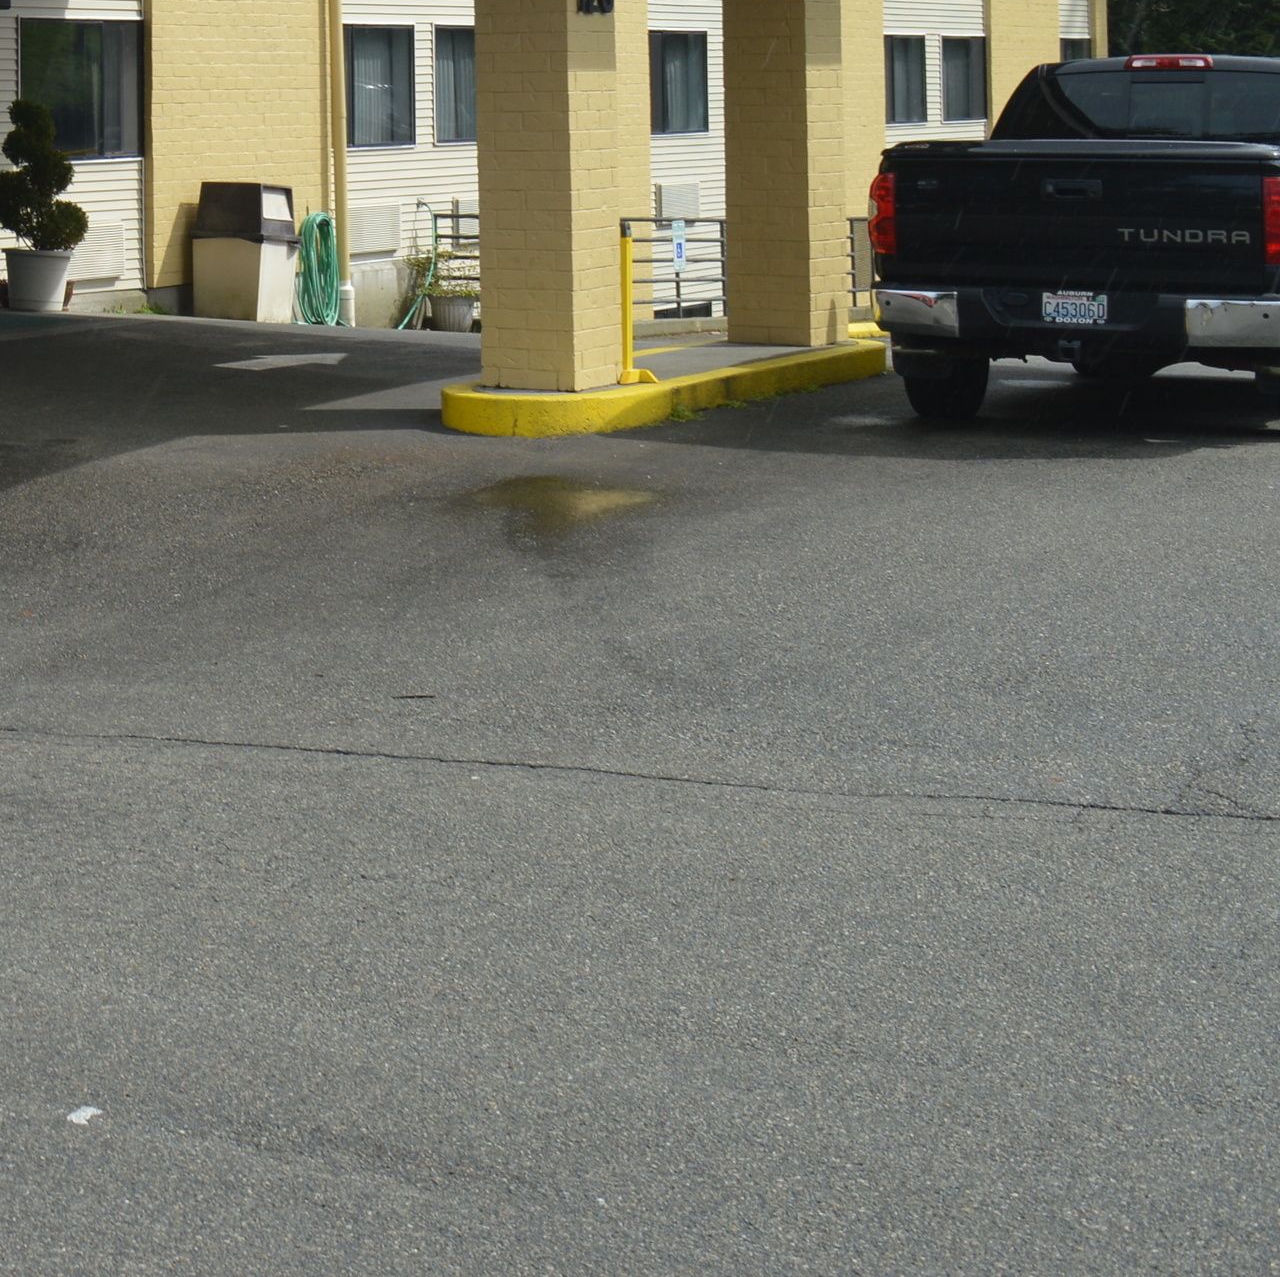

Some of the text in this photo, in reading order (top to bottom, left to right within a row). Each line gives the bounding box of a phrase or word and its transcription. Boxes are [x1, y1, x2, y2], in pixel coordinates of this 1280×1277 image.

[1117, 228, 1251, 244] TUNDRA
[1056, 289, 1094, 297] AUBURN
[1044, 300, 1105, 319] C45306D
